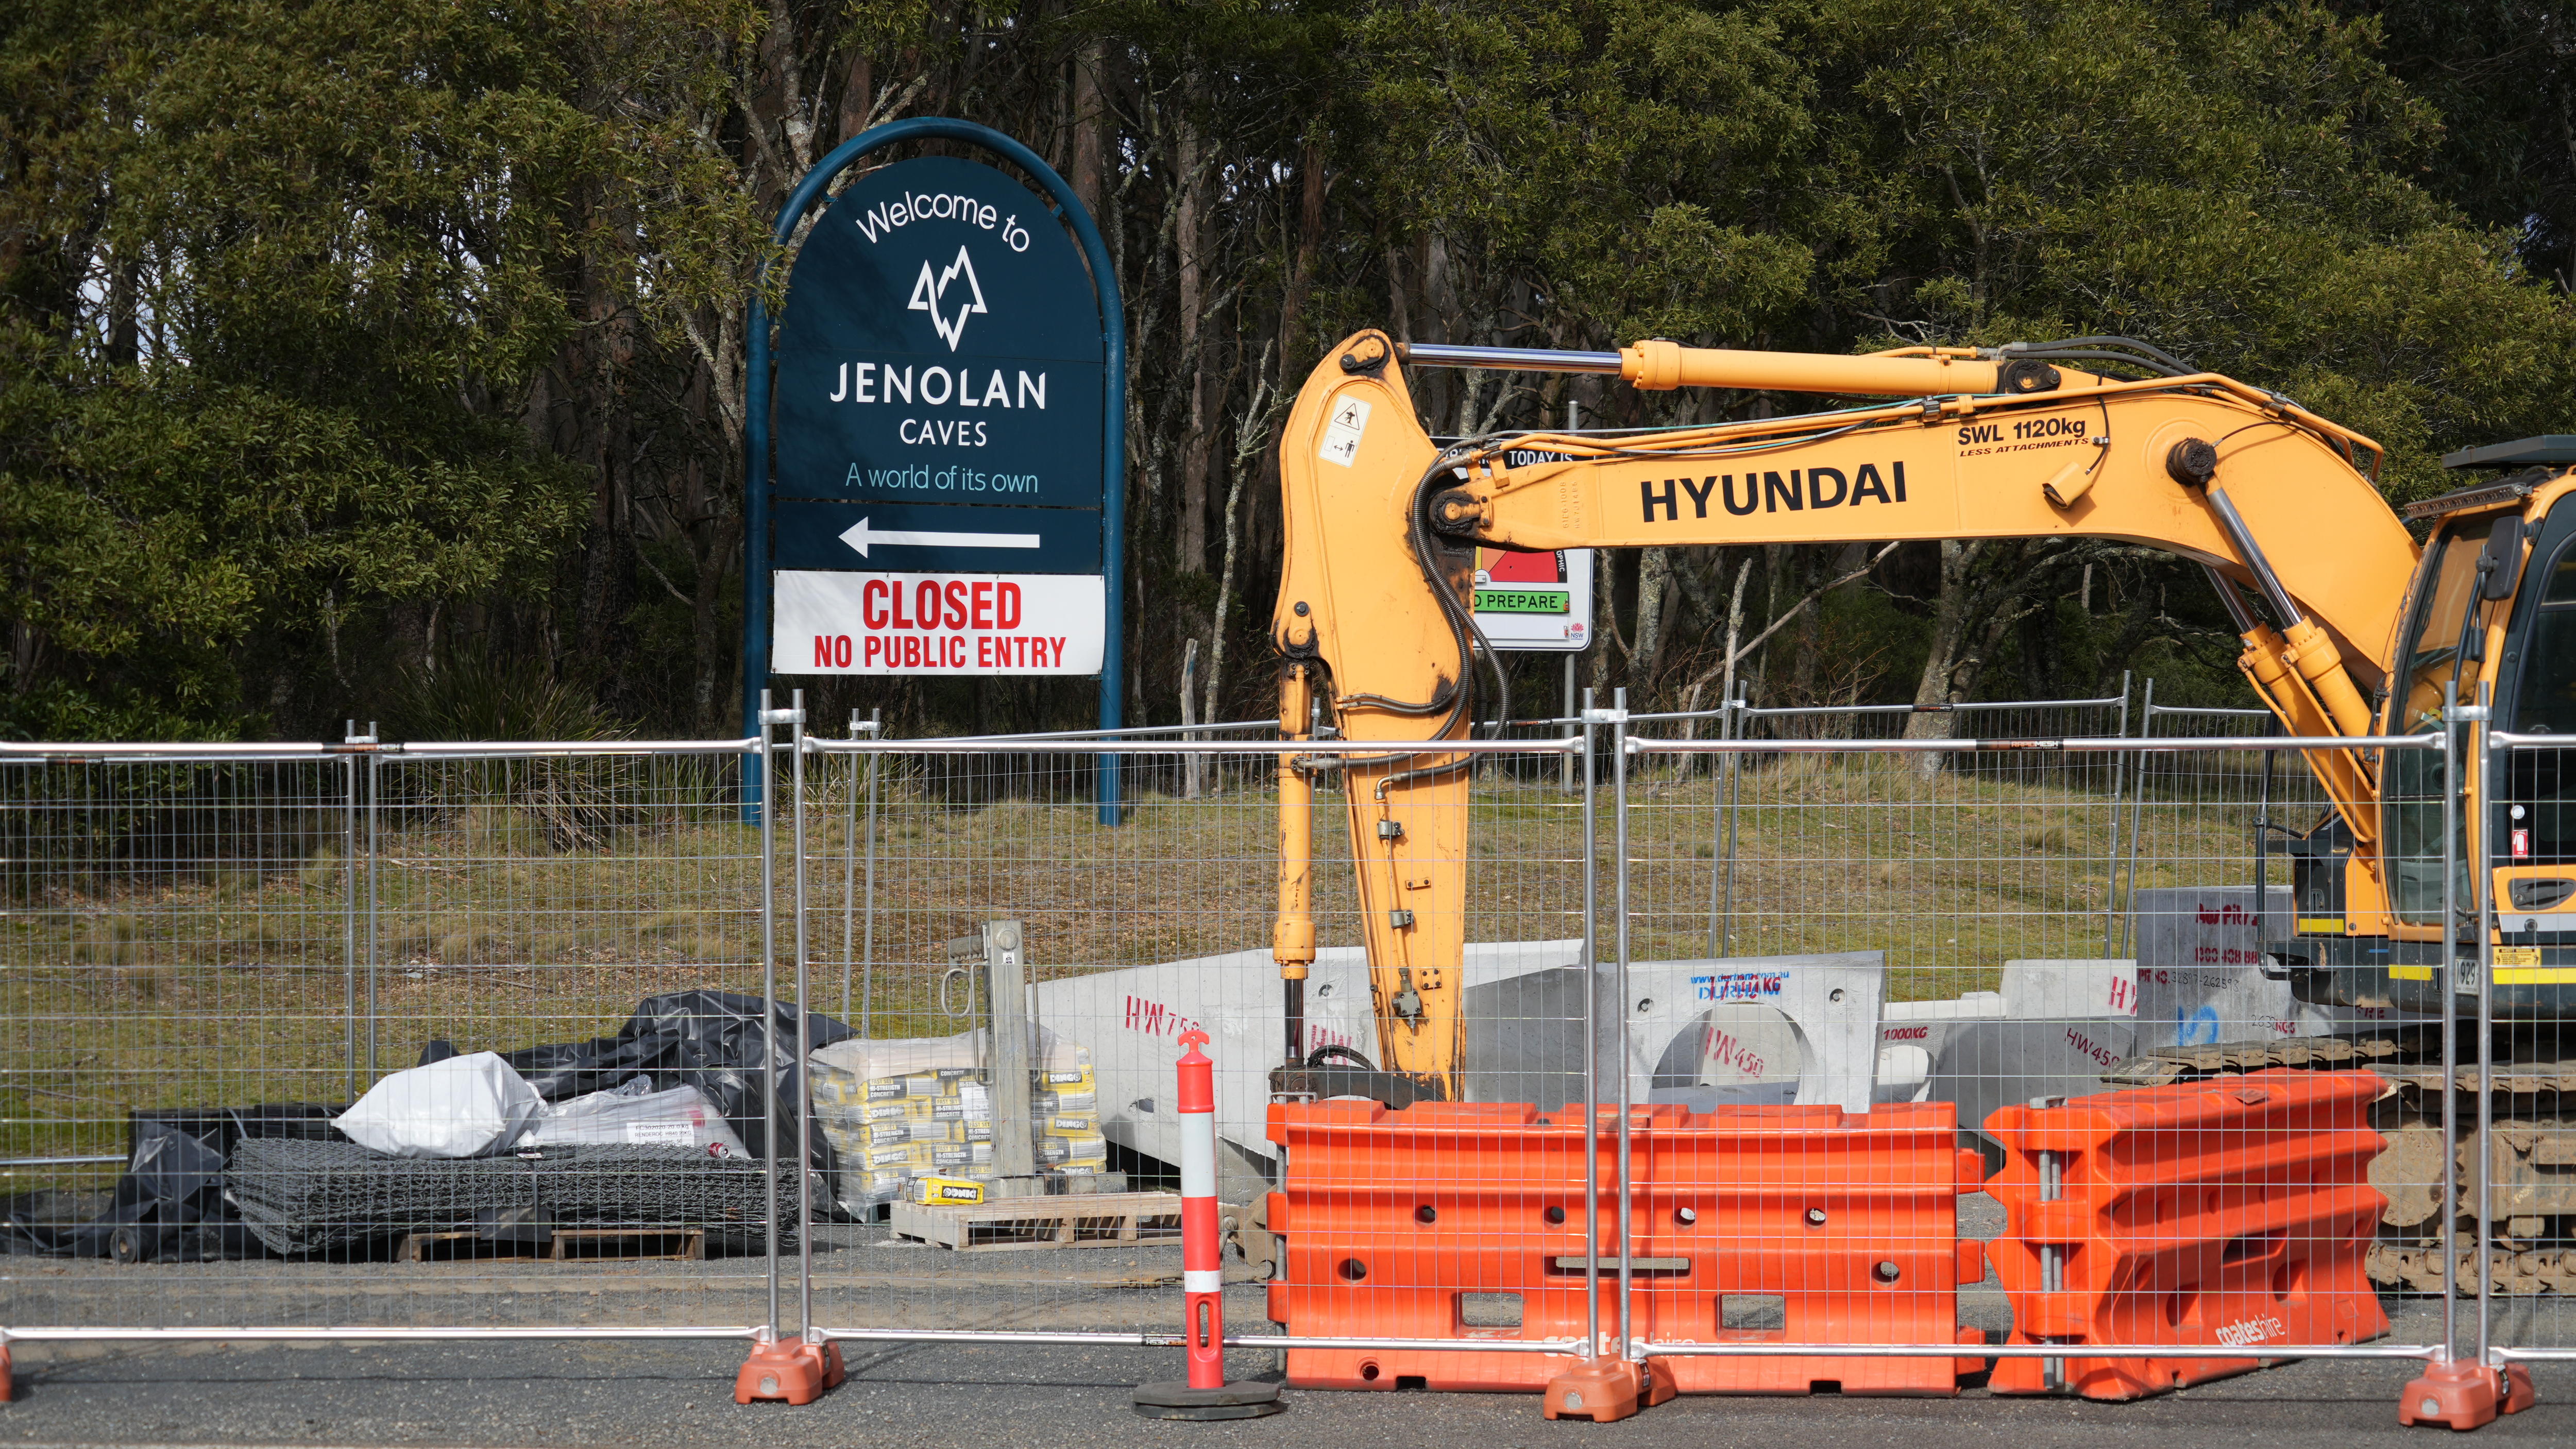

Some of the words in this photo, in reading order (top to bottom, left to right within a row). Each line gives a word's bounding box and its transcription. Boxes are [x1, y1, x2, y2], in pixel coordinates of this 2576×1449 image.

[856, 192, 996, 243] Welcome
[1003, 215, 1029, 252] to
[831, 363, 1045, 409] JENOLAN
[900, 419, 986, 446] CAVES
[1958, 424, 2004, 445] SWL
[2013, 418, 2086, 438] 1120kg
[1509, 451, 1554, 465] TODAY
[1960, 448, 1991, 456] LESS
[1996, 438, 2089, 453] ATTACHMENTS
[846, 463, 861, 486] A
[869, 464, 928, 488] world
[935, 466, 957, 489] of
[962, 467, 986, 490] its
[992, 474, 1037, 492] own
[1641, 462, 1906, 522] HYUNDAI
[1556, 550, 1565, 572] OPHIC
[863, 579, 1021, 630] CLOSED
[1487, 594, 1558, 608] PREPARE
[815, 635, 852, 668] NO
[866, 636, 966, 668] PUBLIC
[978, 637, 1066, 668] ENTRY
[943, 1187, 977, 1199] DINGO
